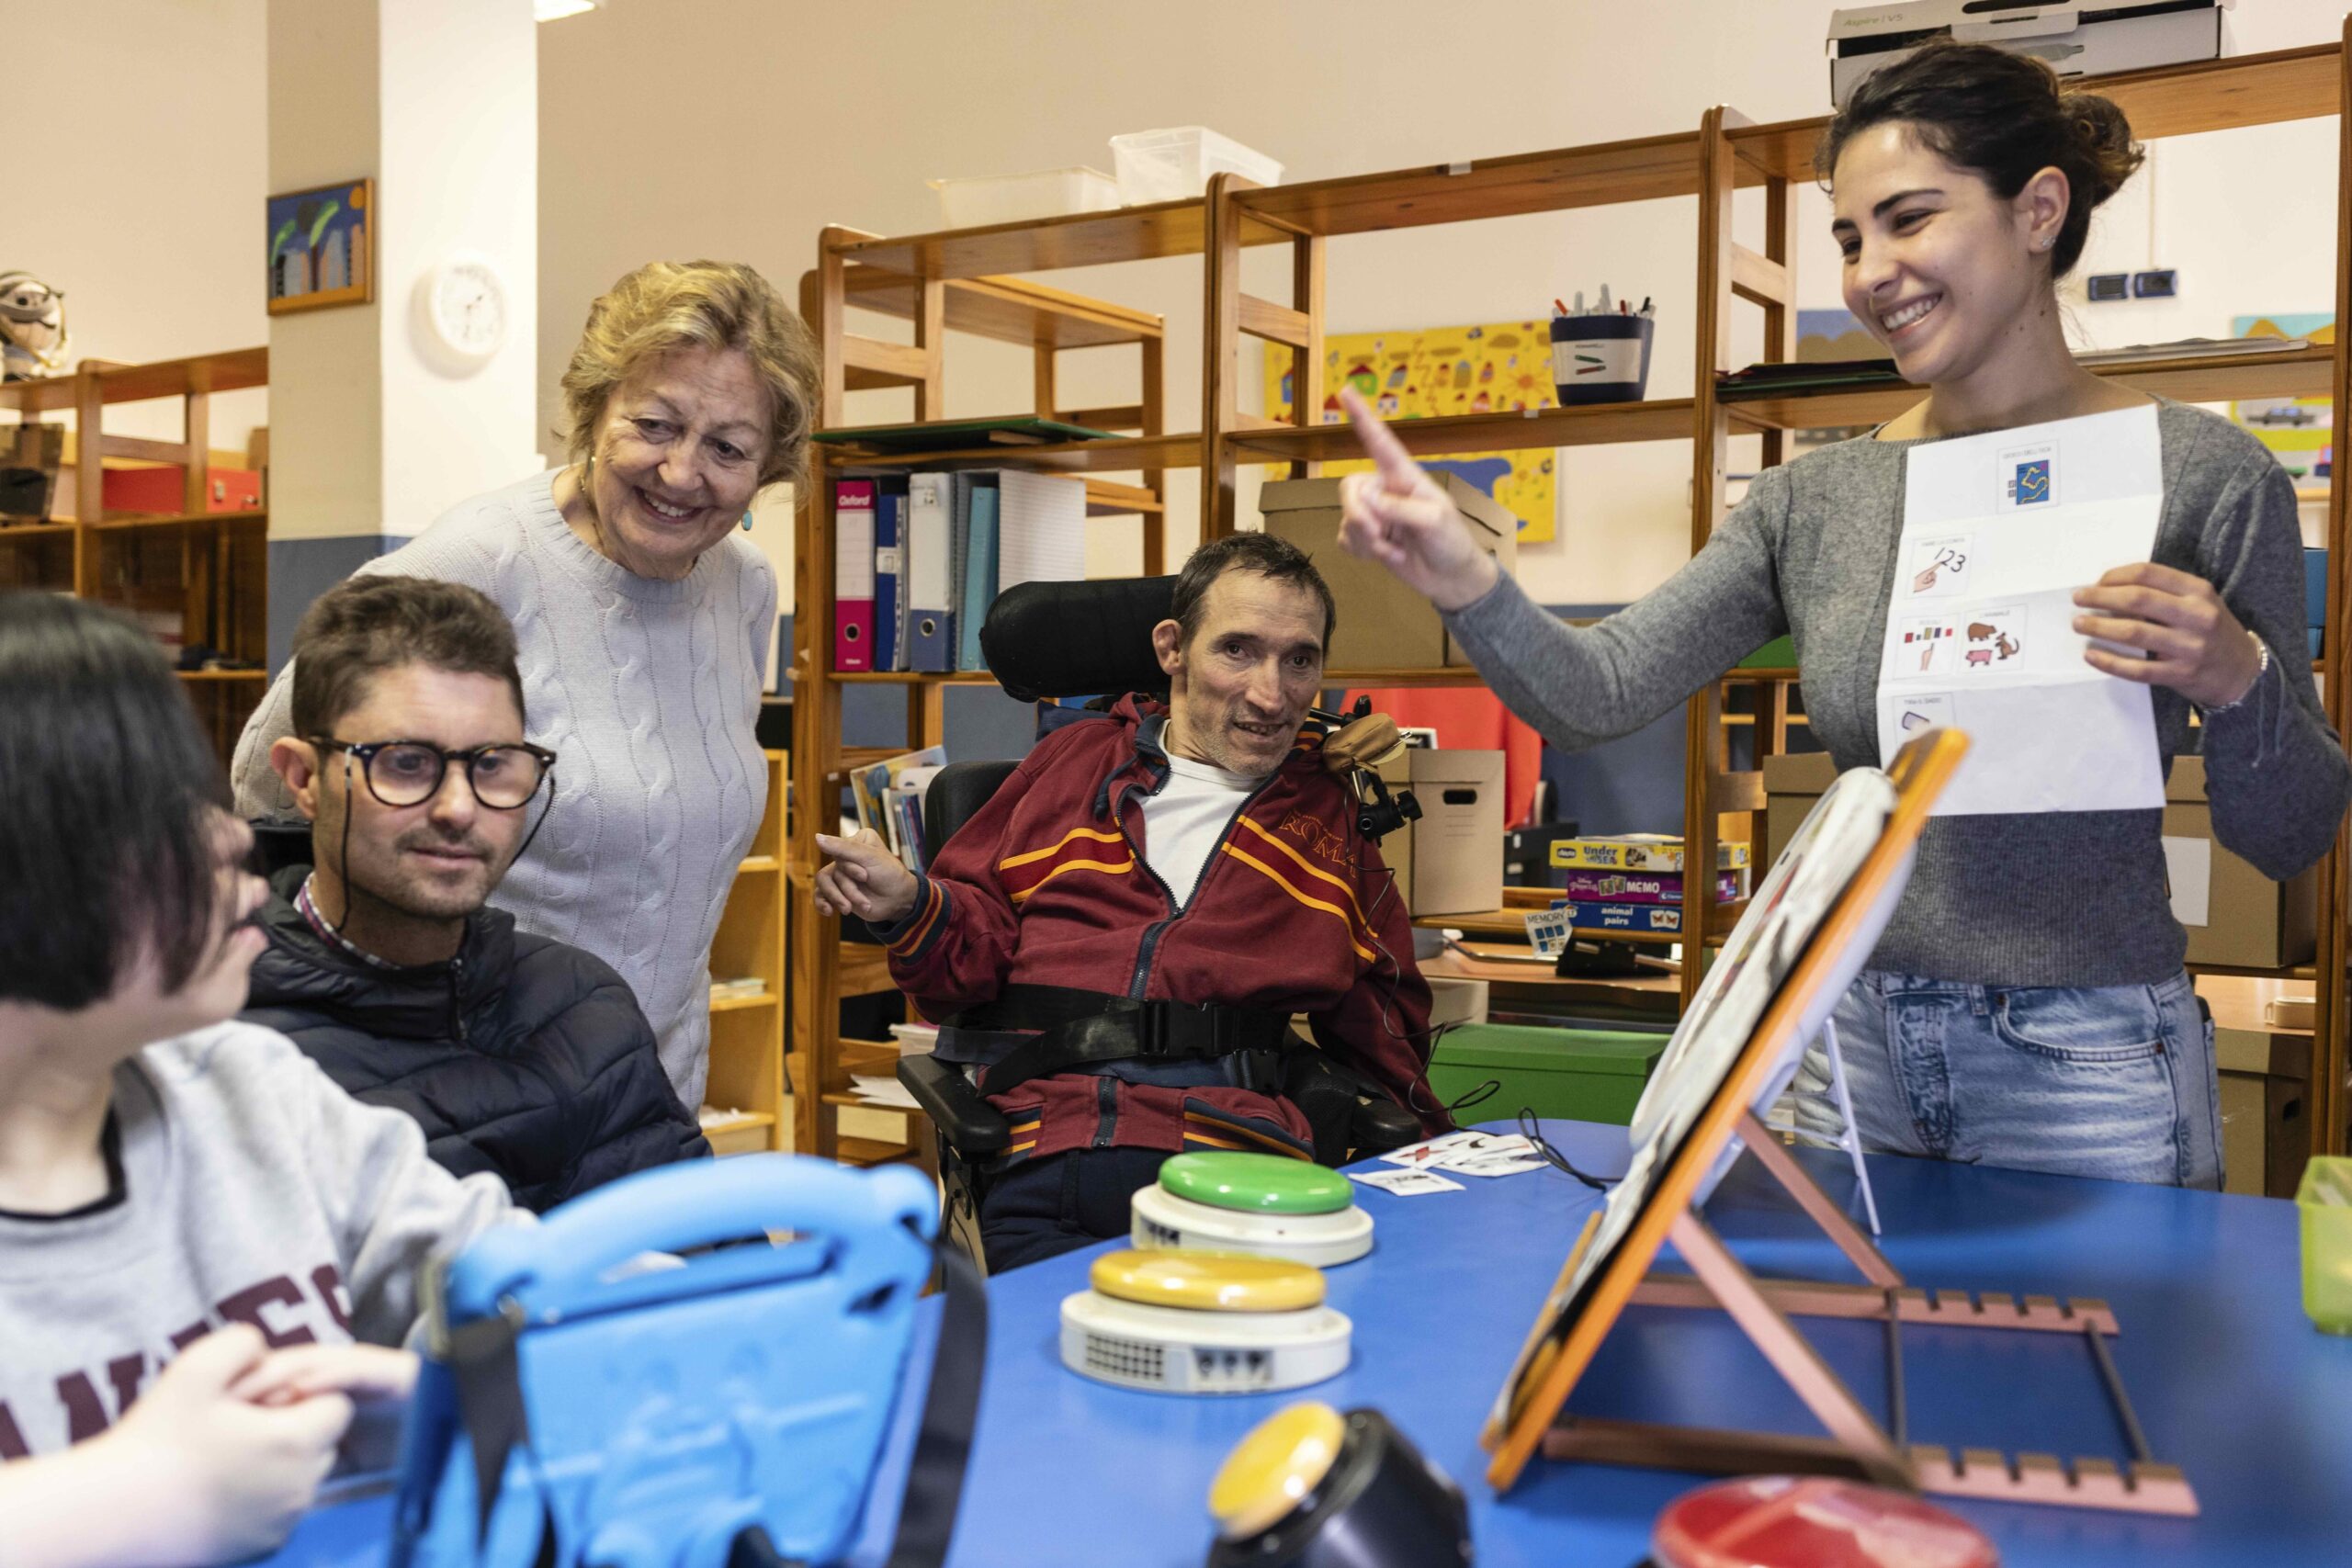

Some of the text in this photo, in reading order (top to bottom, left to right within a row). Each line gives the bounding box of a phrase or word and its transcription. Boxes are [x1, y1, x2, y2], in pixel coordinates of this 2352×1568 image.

[1844, 17, 1879, 27] Aspire
[838, 494, 872, 506] Oxford
[1583, 845, 1618, 856] Under
[1625, 881, 1660, 894] MEMO
[1527, 910, 1566, 922] MEMORY
[1601, 907, 1634, 916] animal
[1603, 916, 1630, 926] pairs
